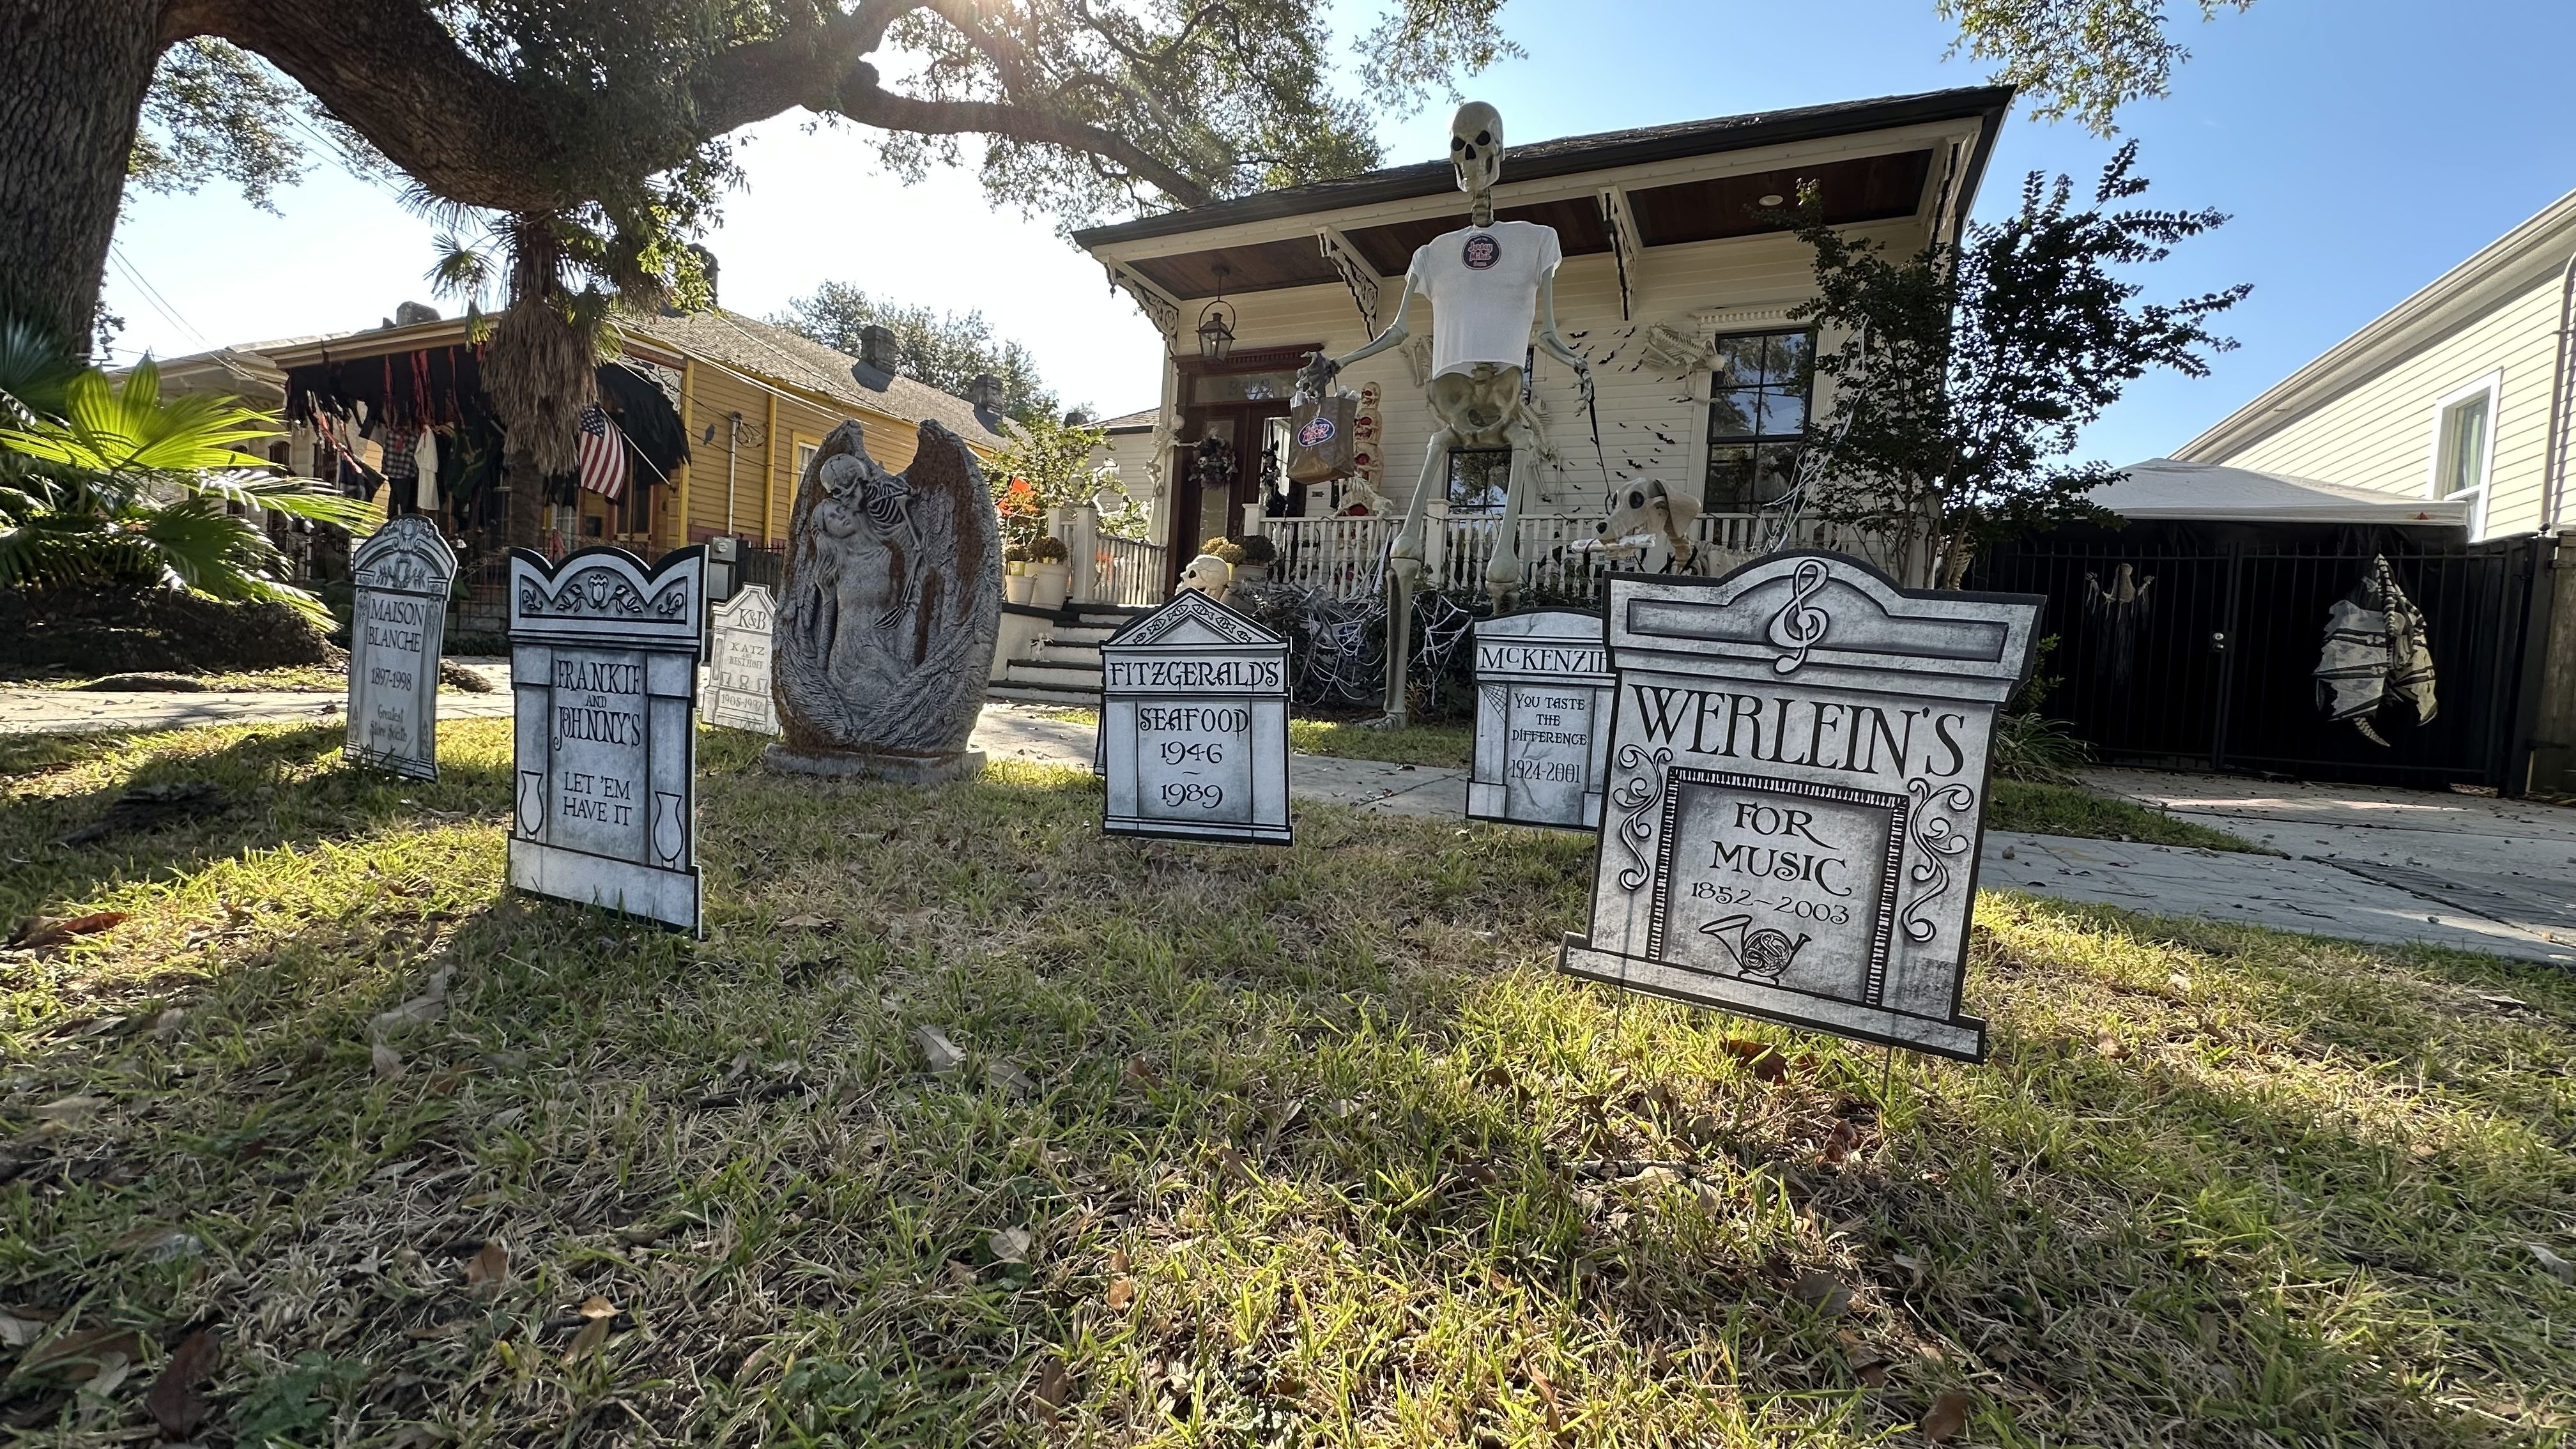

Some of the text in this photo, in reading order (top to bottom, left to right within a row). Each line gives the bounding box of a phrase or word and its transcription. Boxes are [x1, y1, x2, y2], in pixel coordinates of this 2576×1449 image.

[370, 599, 425, 626] MAISON
[736, 608, 766, 630] K&B
[368, 626, 421, 652] BLANCHE
[730, 641, 765, 656] KATZ
[729, 656, 763, 670] BESTHOFF
[371, 667, 412, 691] 1897-1998
[556, 659, 640, 695] FRANKIE
[1108, 661, 1280, 693] FITZGERALD'S
[585, 694, 607, 709] AND
[721, 693, 762, 712] 1905-1997
[1544, 697, 1585, 710] TASTE
[553, 705, 641, 751] JOHNNY'S
[1140, 707, 1249, 741] SEAFOOD
[1536, 714, 1560, 726] THE
[1627, 684, 1966, 779] WERLEIN'S
[1512, 728, 1588, 748] DIFFERENCE
[1160, 740, 1223, 765] 1946
[1511, 759, 1580, 783] 1924-2001
[564, 771, 631, 800] LET 'EM
[1160, 783, 1223, 809] 1989
[563, 796, 632, 826] HAVE IT
[1734, 802, 1839, 850] FOR
[1710, 839, 1852, 897] MUSIC
